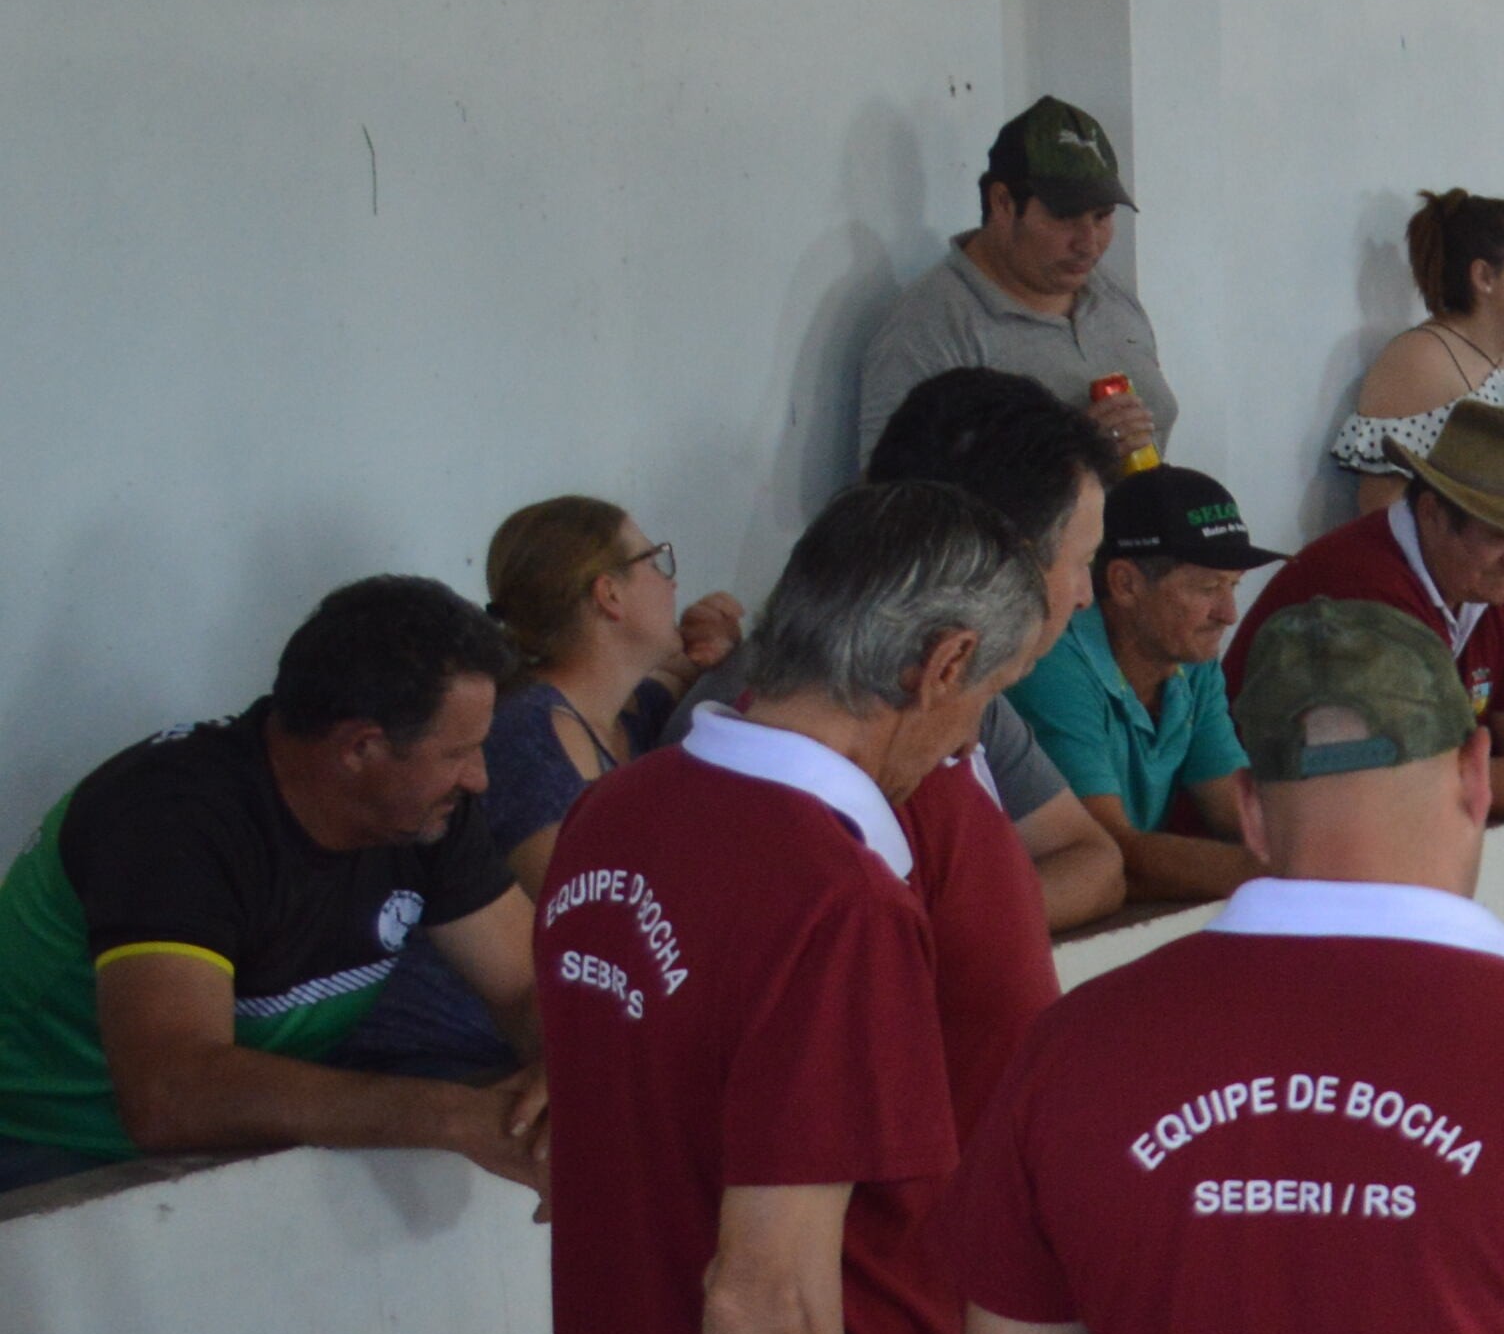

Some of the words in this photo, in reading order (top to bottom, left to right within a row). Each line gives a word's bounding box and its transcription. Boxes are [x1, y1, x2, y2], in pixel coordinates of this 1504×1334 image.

[545, 868, 627, 928] EQUIPE
[1129, 1076, 1279, 1171] EQUIPE
[1286, 1073, 1340, 1113] DE
[1344, 1080, 1484, 1176] BOCHA
[1193, 1178, 1333, 1216] SEBERI
[1362, 1183, 1417, 1219] RS
